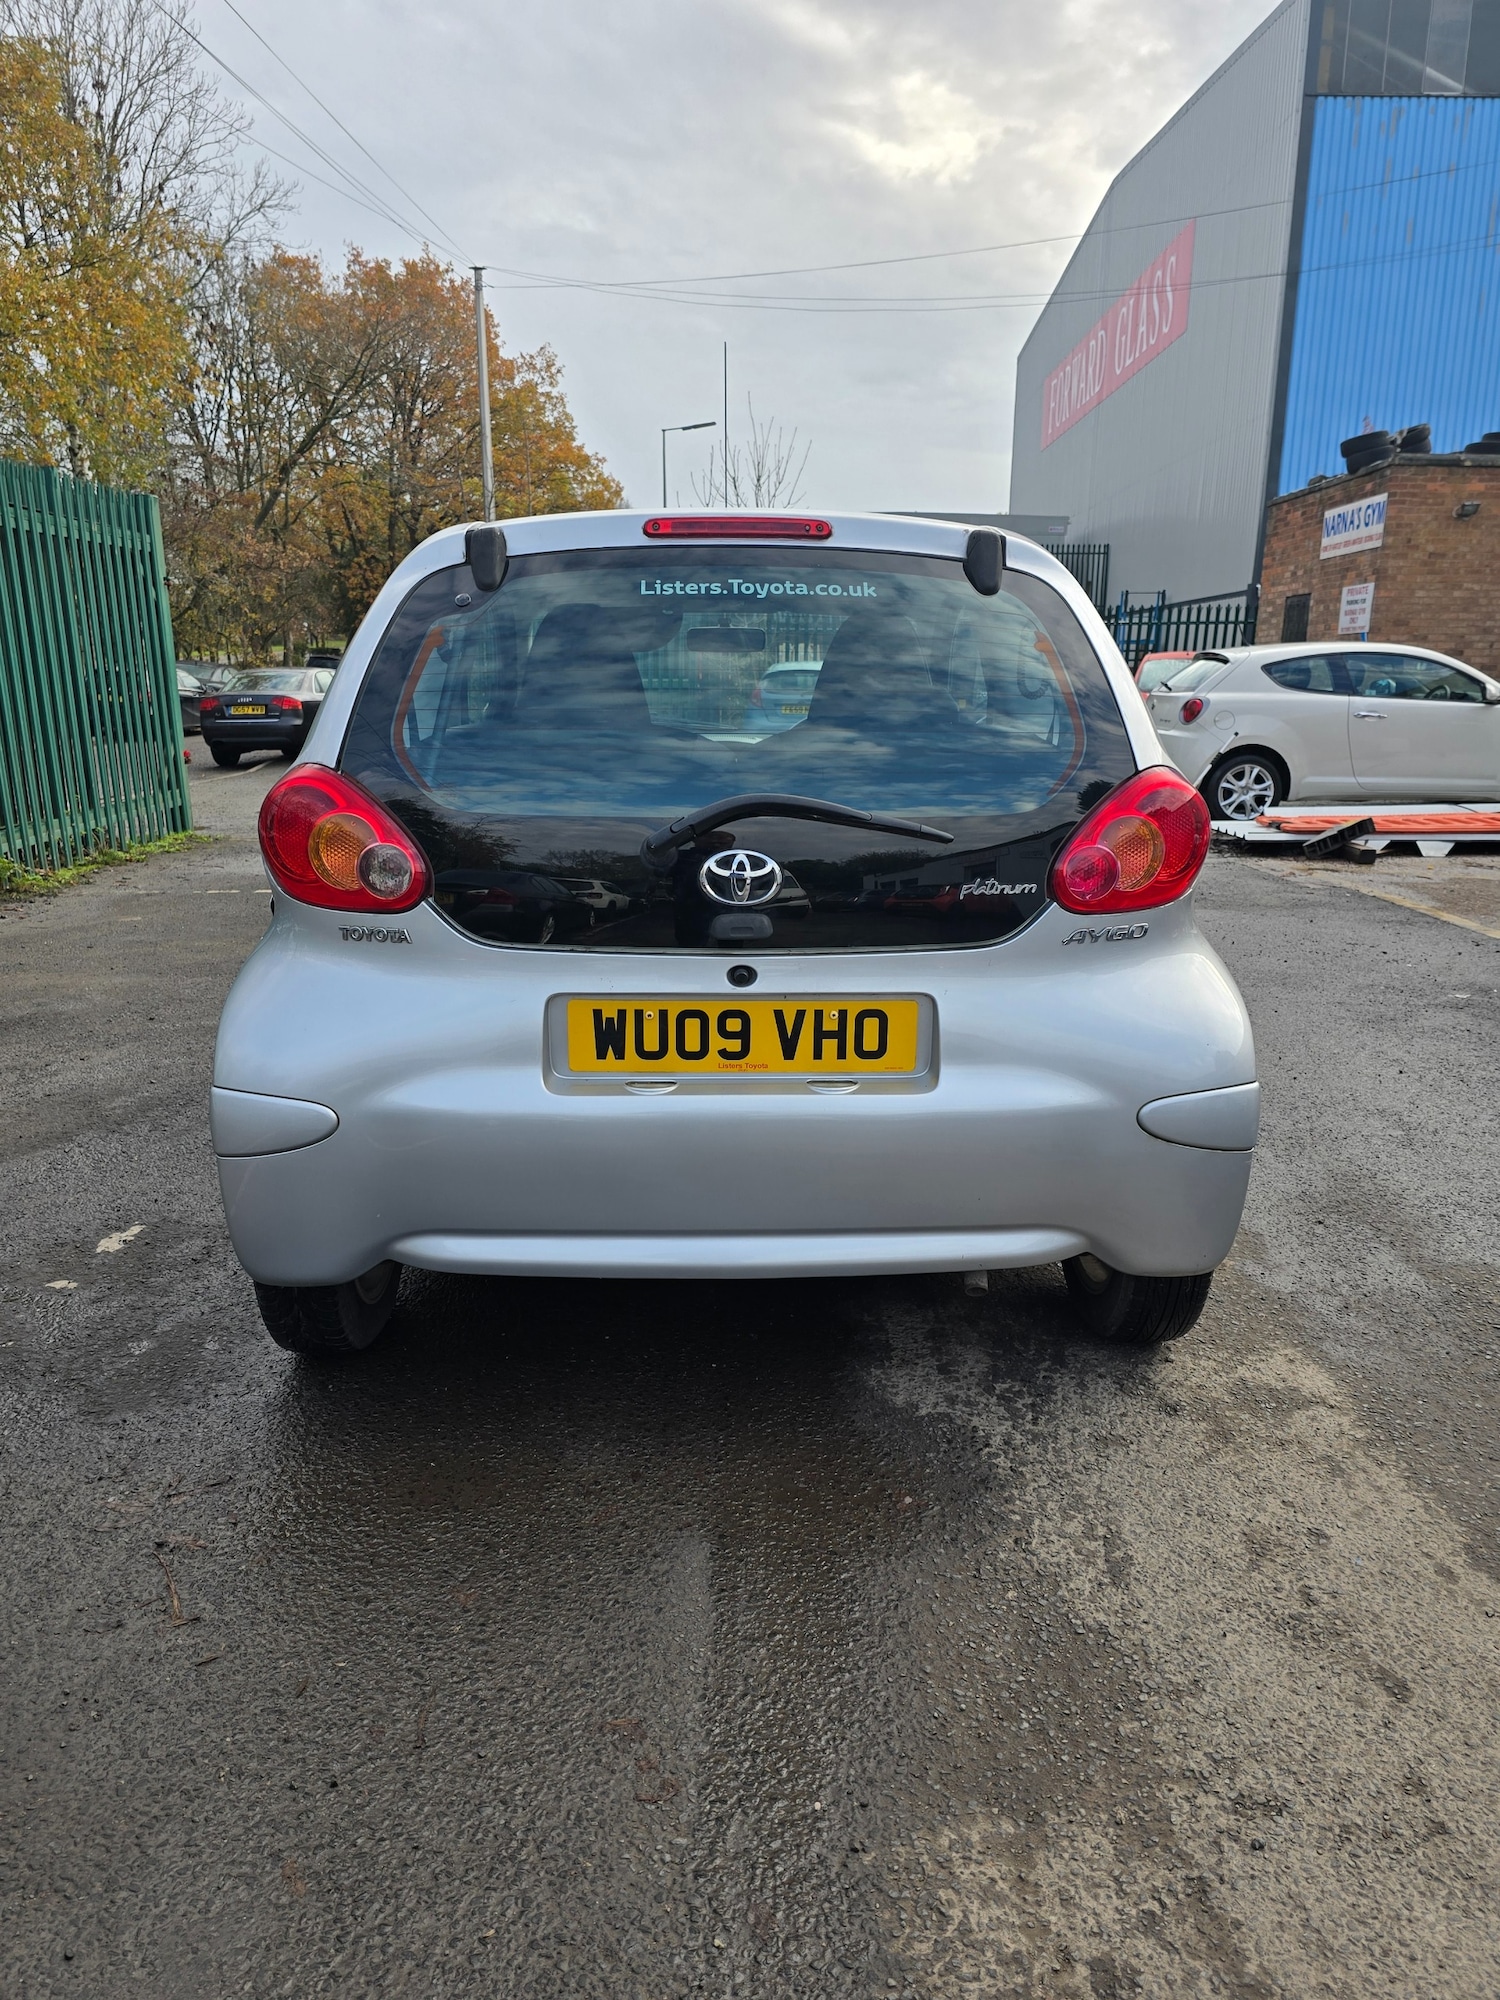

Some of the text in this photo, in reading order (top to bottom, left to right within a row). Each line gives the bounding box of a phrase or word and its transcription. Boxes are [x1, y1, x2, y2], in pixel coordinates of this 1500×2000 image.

[1047, 255, 1177, 434] FORWARD GLASS
[1323, 500, 1386, 538] NARNA'S GYM
[640, 578, 877, 599] Listers.Toyota.co.uk
[1346, 585, 1369, 596] PRIVATE
[960, 878, 1038, 900] platinum
[339, 925, 413, 944] TOYOTA
[1061, 922, 1149, 946] AYGO
[592, 1008, 888, 1061] WU09 VHO
[745, 1062, 769, 1070] Toyota
